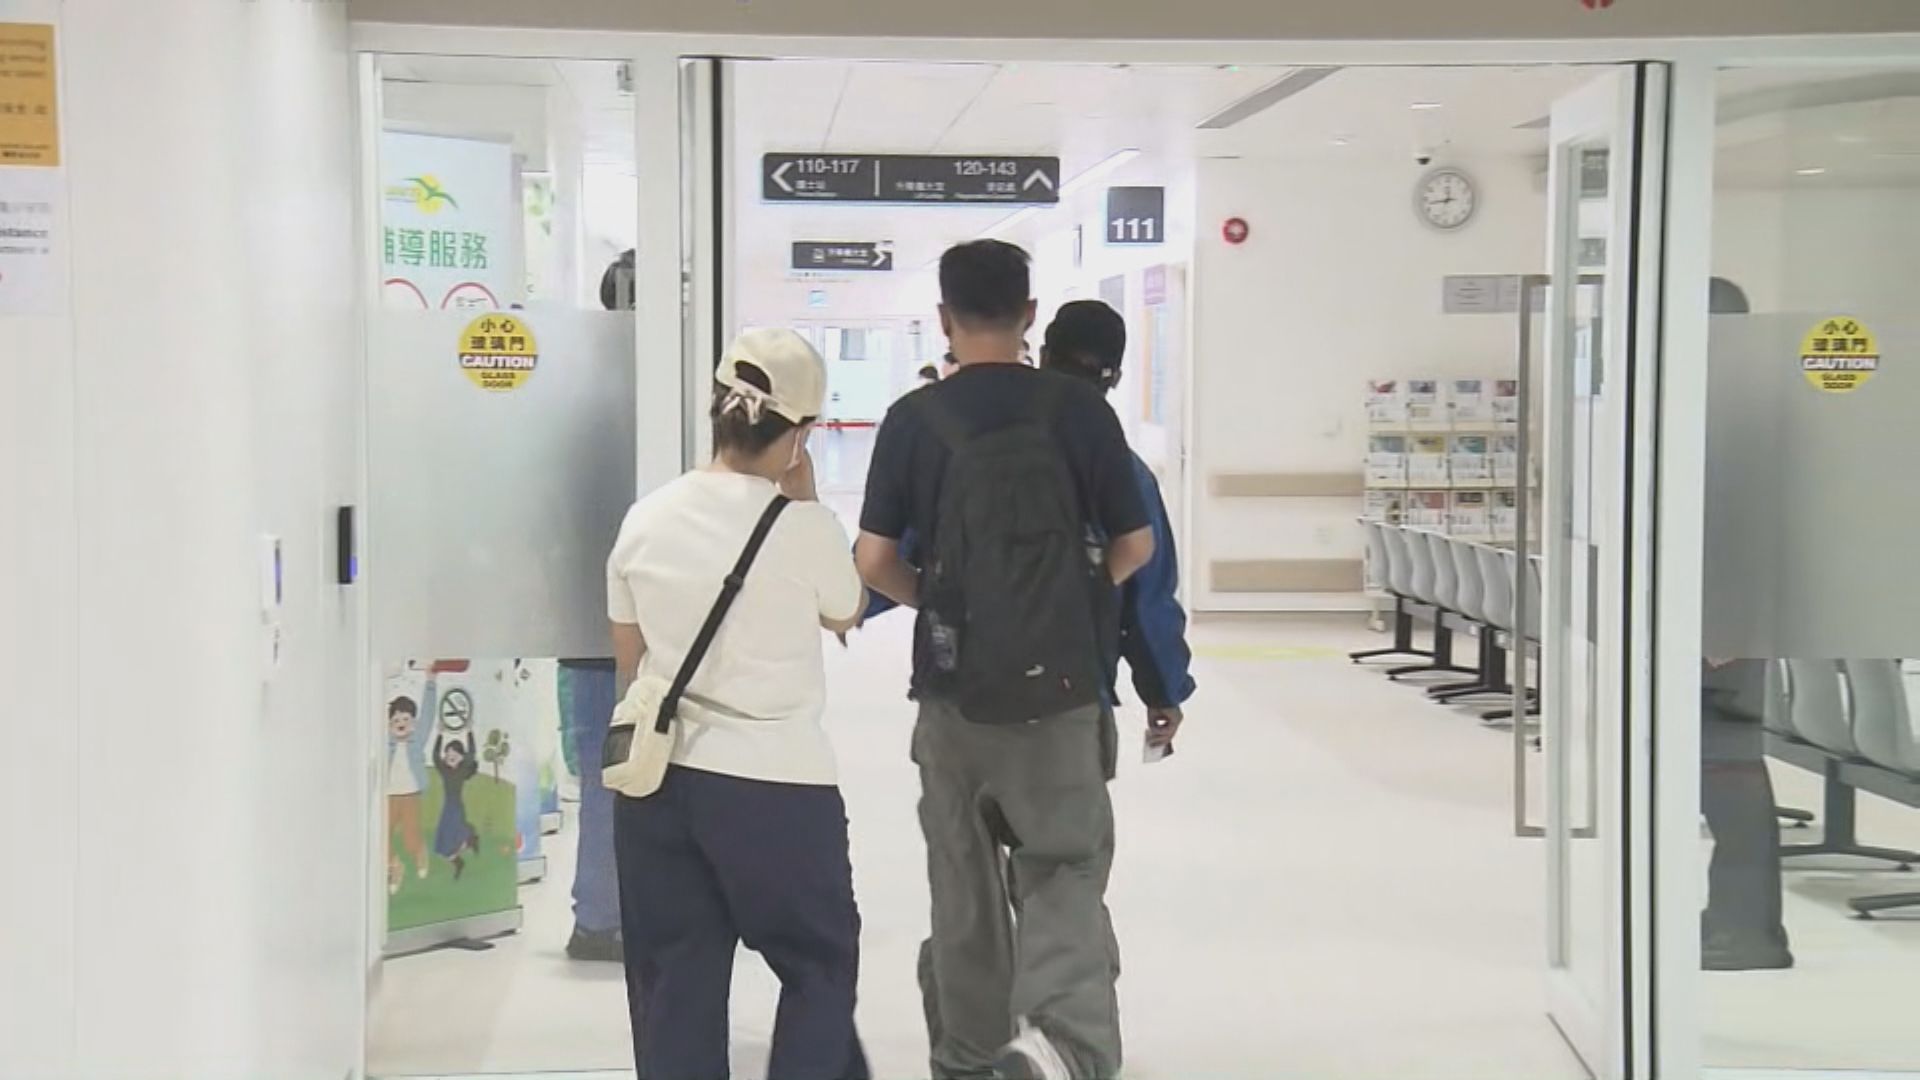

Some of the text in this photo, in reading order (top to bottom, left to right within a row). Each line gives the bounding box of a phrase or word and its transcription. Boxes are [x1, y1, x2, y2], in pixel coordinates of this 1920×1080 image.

[796, 158, 860, 174] 110-117
[954, 161, 1017, 176] 120-143
[1111, 217, 1155, 240] 111
[480, 318, 514, 333] 小心
[462, 355, 534, 369] CAUTION
[1804, 357, 1876, 370] CAUTION
